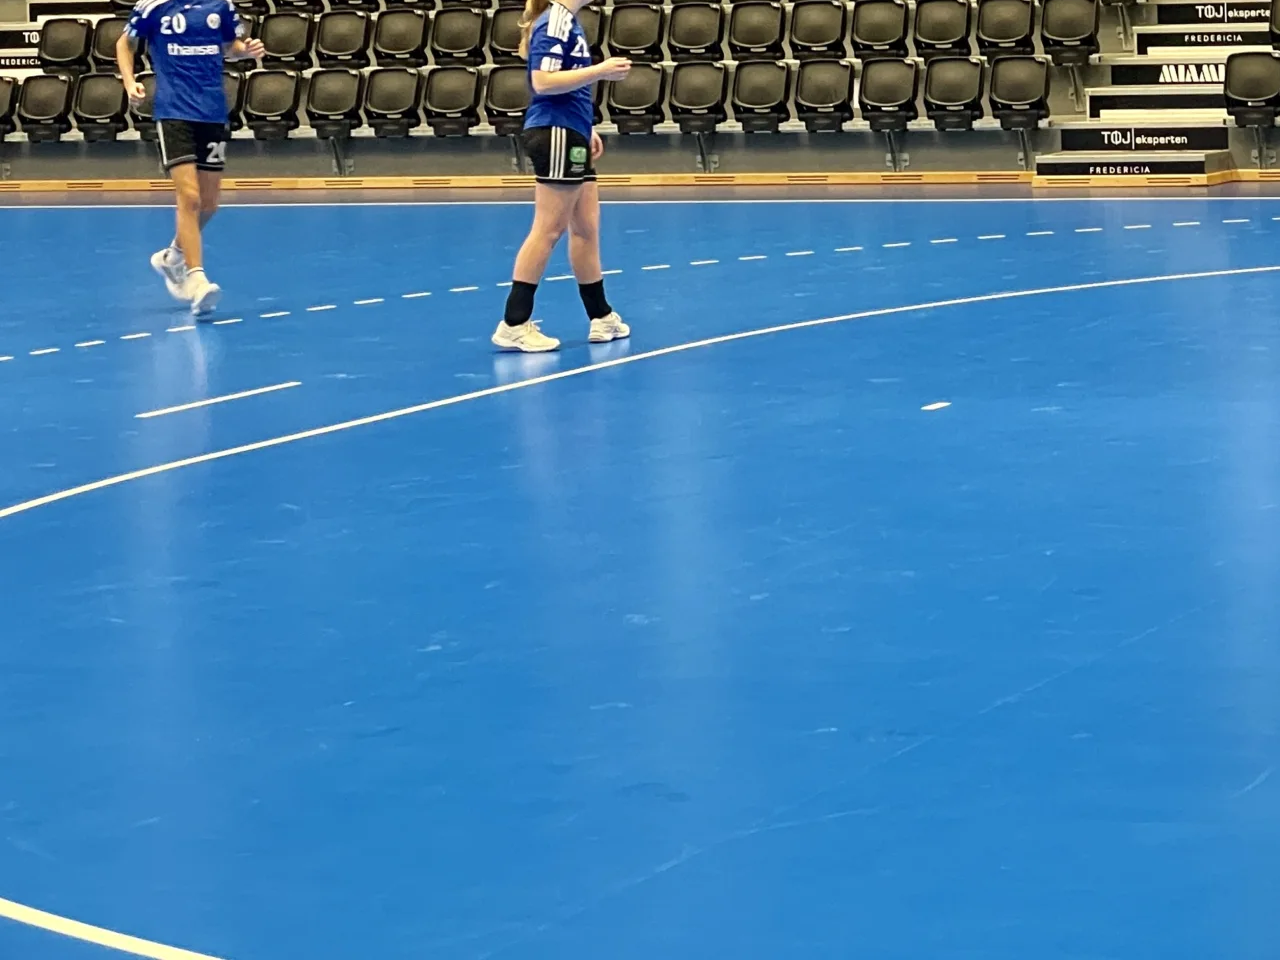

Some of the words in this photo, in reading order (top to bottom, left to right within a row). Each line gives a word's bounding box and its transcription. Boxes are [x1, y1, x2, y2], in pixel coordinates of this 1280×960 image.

[160, 13, 187, 36] 20
[1184, 34, 1243, 43] FREDERICIA
[1158, 64, 1226, 83] MIAMI
[1135, 133, 1188, 147] eksperten
[1089, 165, 1151, 175] FREDERICIA
